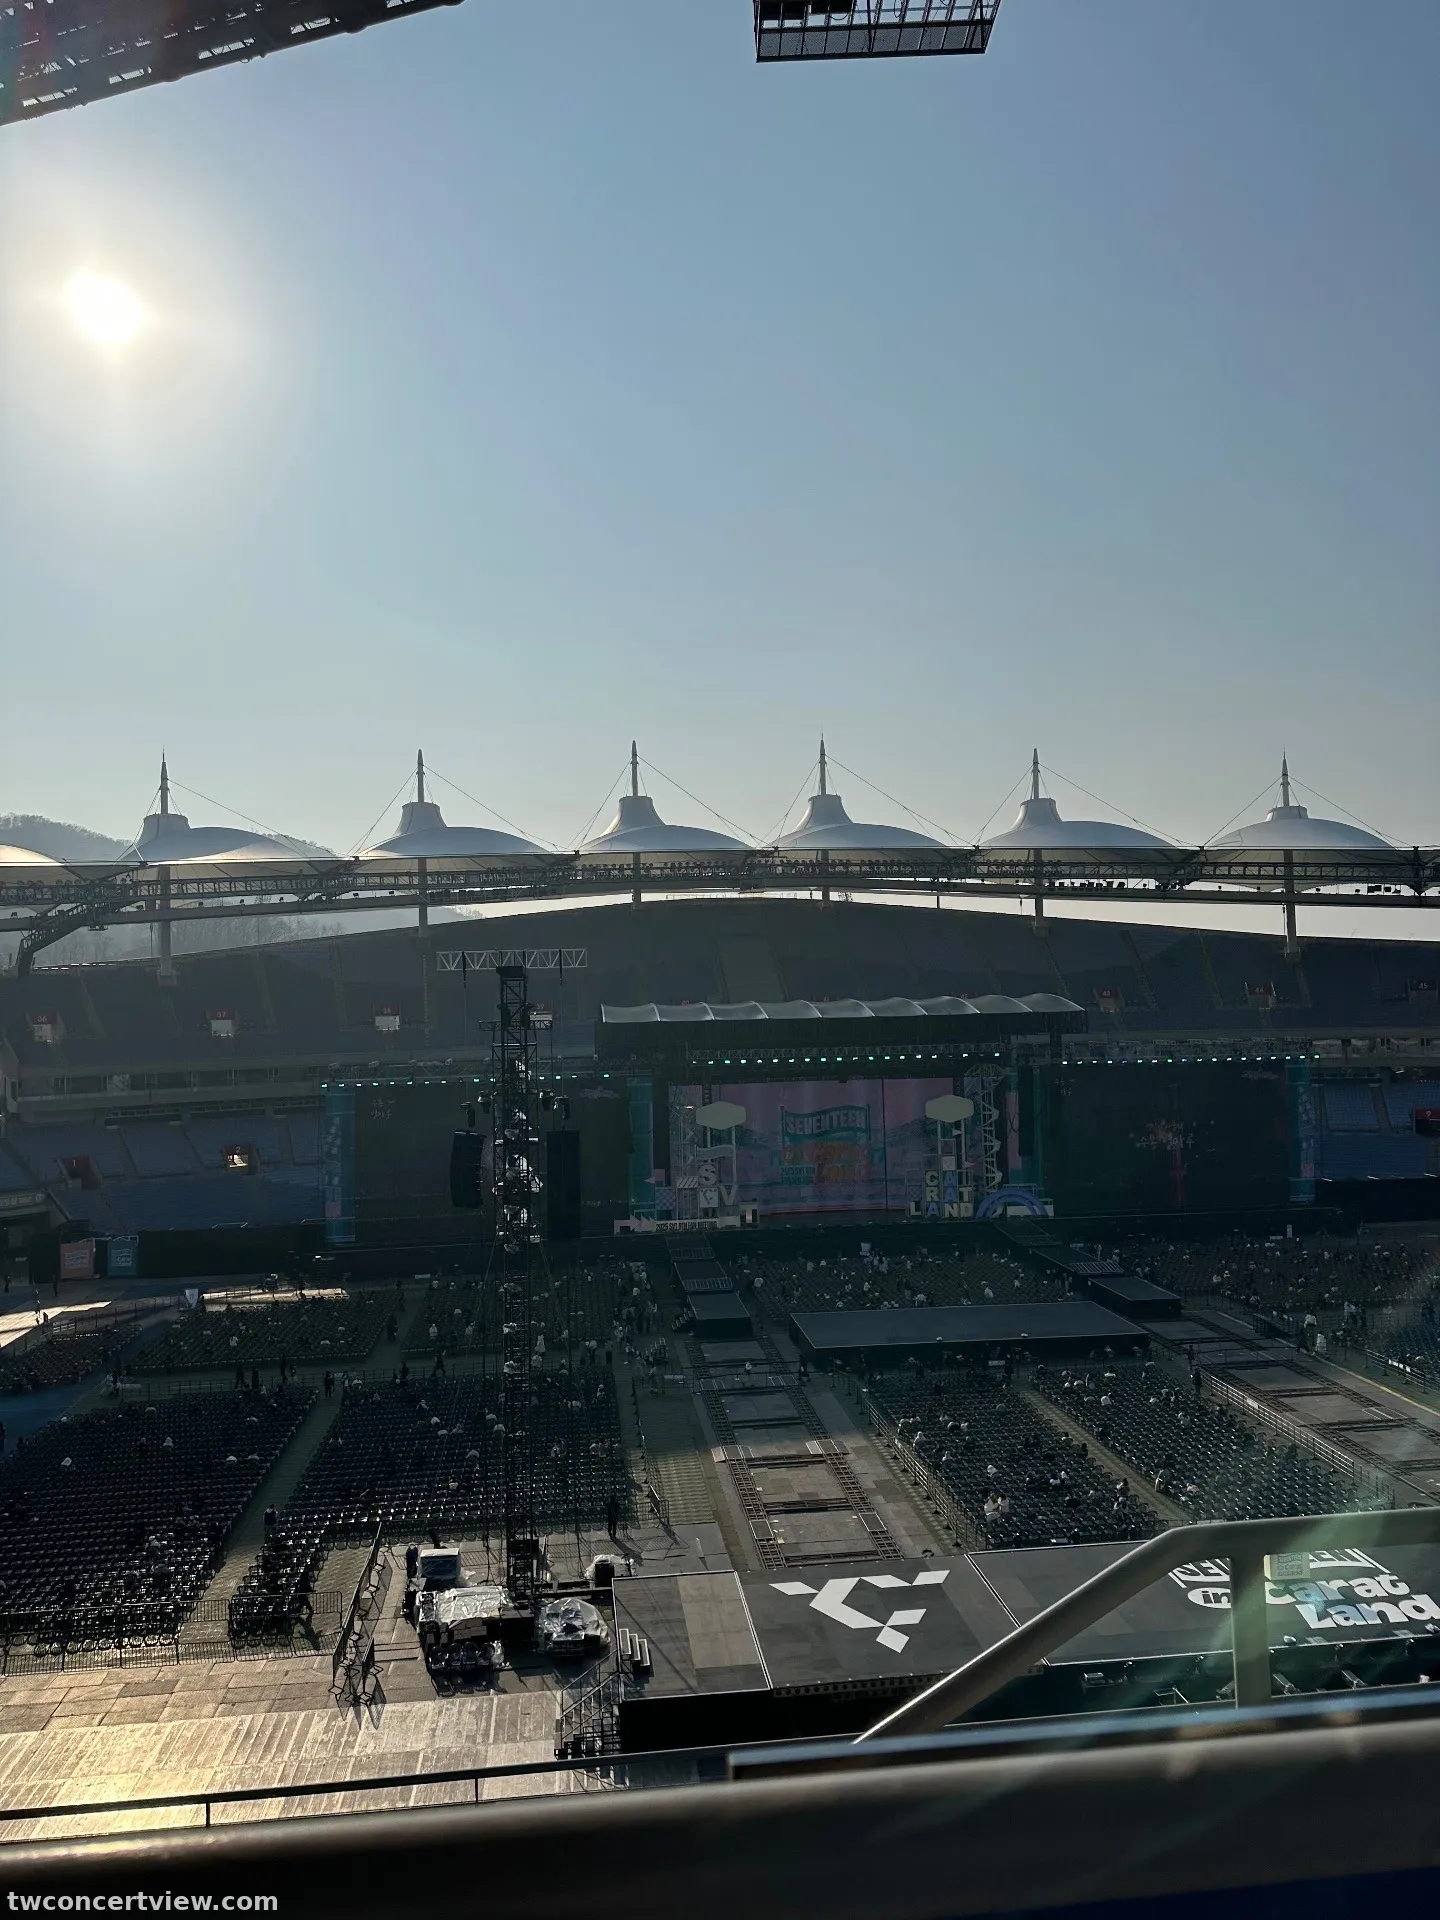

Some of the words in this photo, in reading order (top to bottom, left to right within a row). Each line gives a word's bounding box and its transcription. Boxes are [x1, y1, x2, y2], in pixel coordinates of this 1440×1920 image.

[37, 1014, 48, 1022] 36
[216, 1010, 227, 1018] 37
[784, 1109, 868, 1136] SEVENTEEN
[910, 1202, 974, 1218] LAND
[1294, 1594, 1440, 1629] Land
